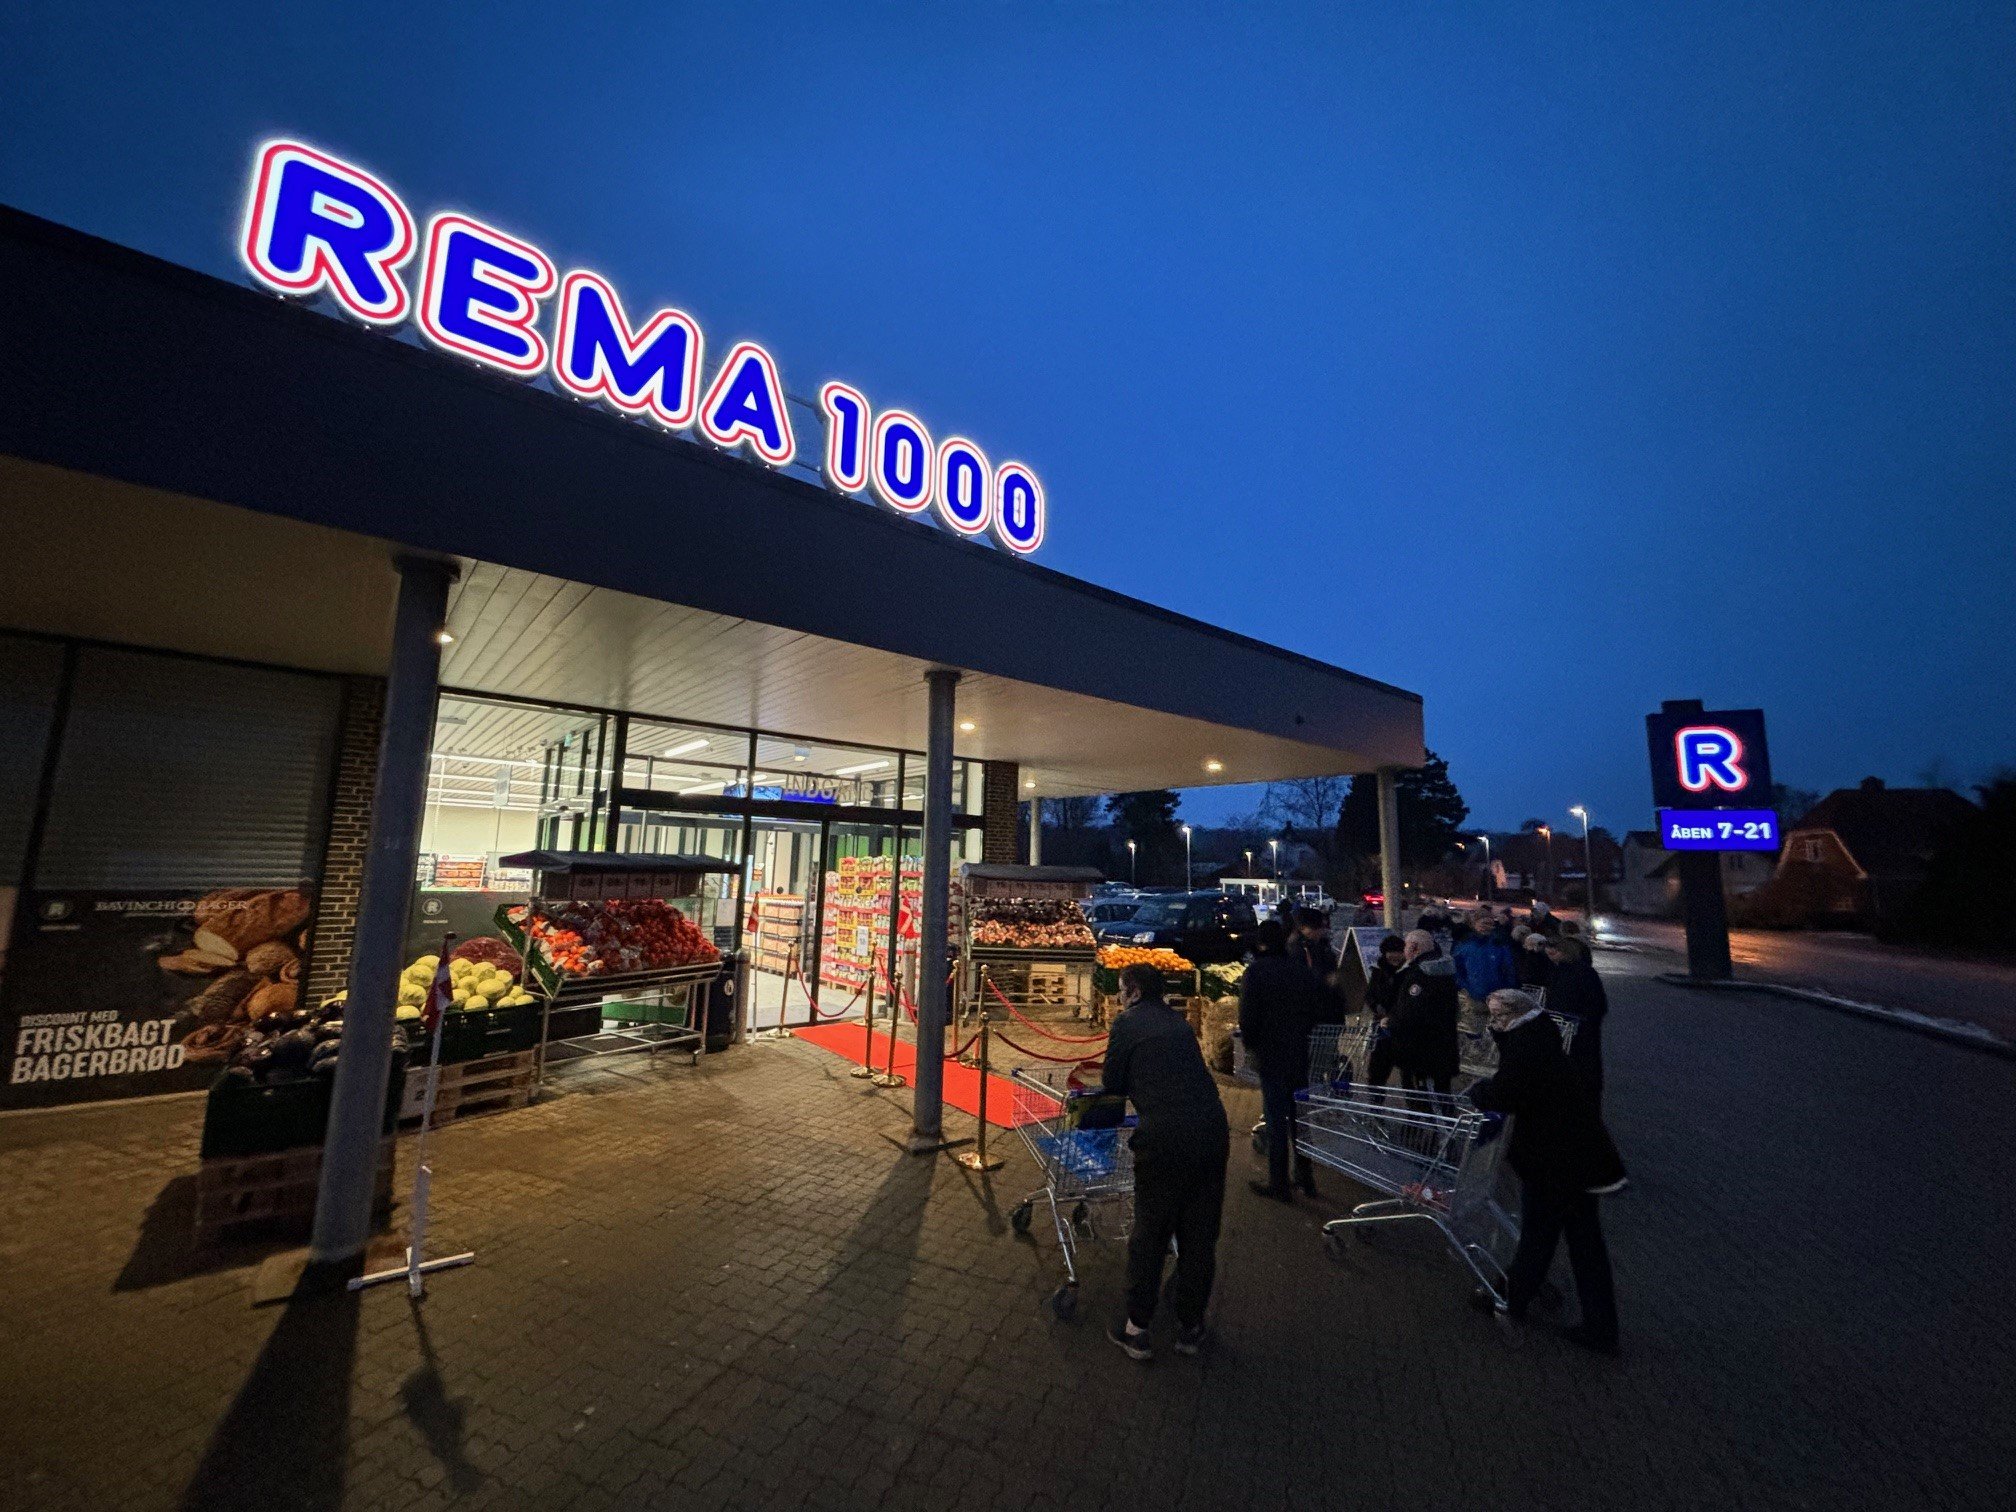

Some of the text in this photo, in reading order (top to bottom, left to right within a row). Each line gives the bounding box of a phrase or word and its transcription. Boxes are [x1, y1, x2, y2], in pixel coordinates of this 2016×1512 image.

[242, 139, 1045, 555] REMA 1000
[1674, 725, 1748, 793] R
[1670, 821, 1773, 840] ÅBEN 7-21
[89, 1009, 119, 1023] MED
[15, 1018, 178, 1055] FRISKBAGT
[10, 1043, 187, 1084] BAGERBRØD
